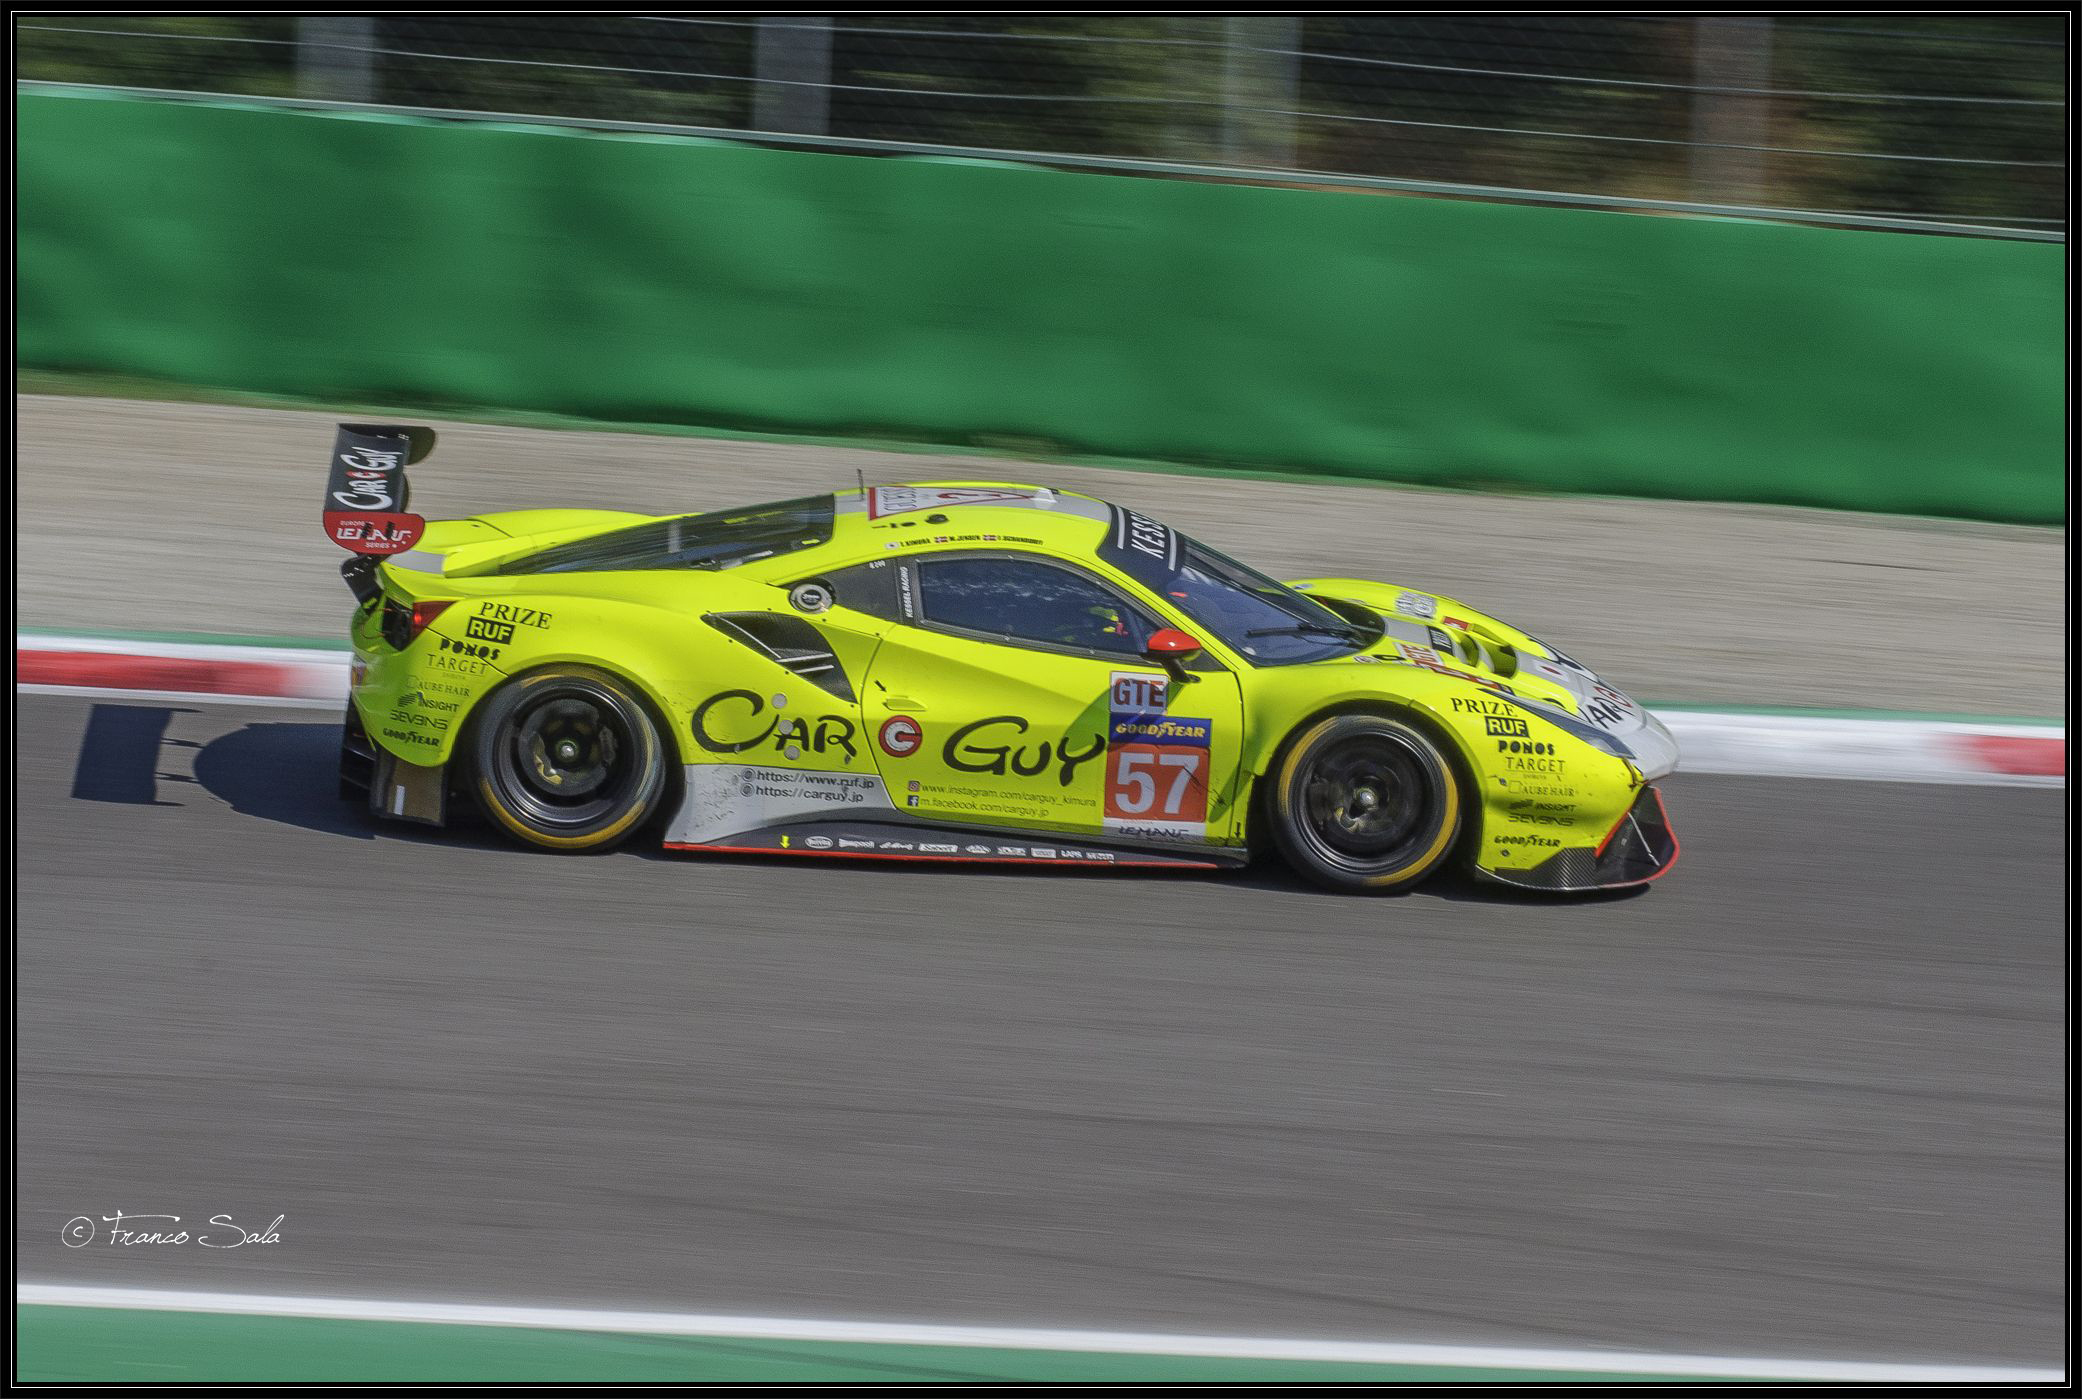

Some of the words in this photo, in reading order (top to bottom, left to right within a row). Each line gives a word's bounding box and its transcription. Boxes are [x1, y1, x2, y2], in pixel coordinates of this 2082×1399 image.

[902, 592, 914, 618] KESSEL
[479, 601, 552, 630] PRIZE
[468, 620, 512, 641] RUF
[440, 638, 500, 660] PONOS
[426, 653, 488, 675] TARGET
[1114, 678, 1166, 707] GTE
[1451, 698, 1518, 717] PRIZE
[1115, 721, 1207, 738] GOODYEAR
[1488, 718, 1527, 736] RUF
[383, 728, 440, 747] GOODYEAR
[691, 689, 857, 758] CAR
[943, 716, 1106, 787] GUY
[1498, 739, 1555, 756] PONOS
[1505, 756, 1567, 774] TARGET
[757, 770, 875, 789] https://www.ruf.jp
[1115, 752, 1200, 815] 57
[755, 786, 864, 803] https://carguy.jp
[1494, 834, 1562, 848] GOODYEAR
